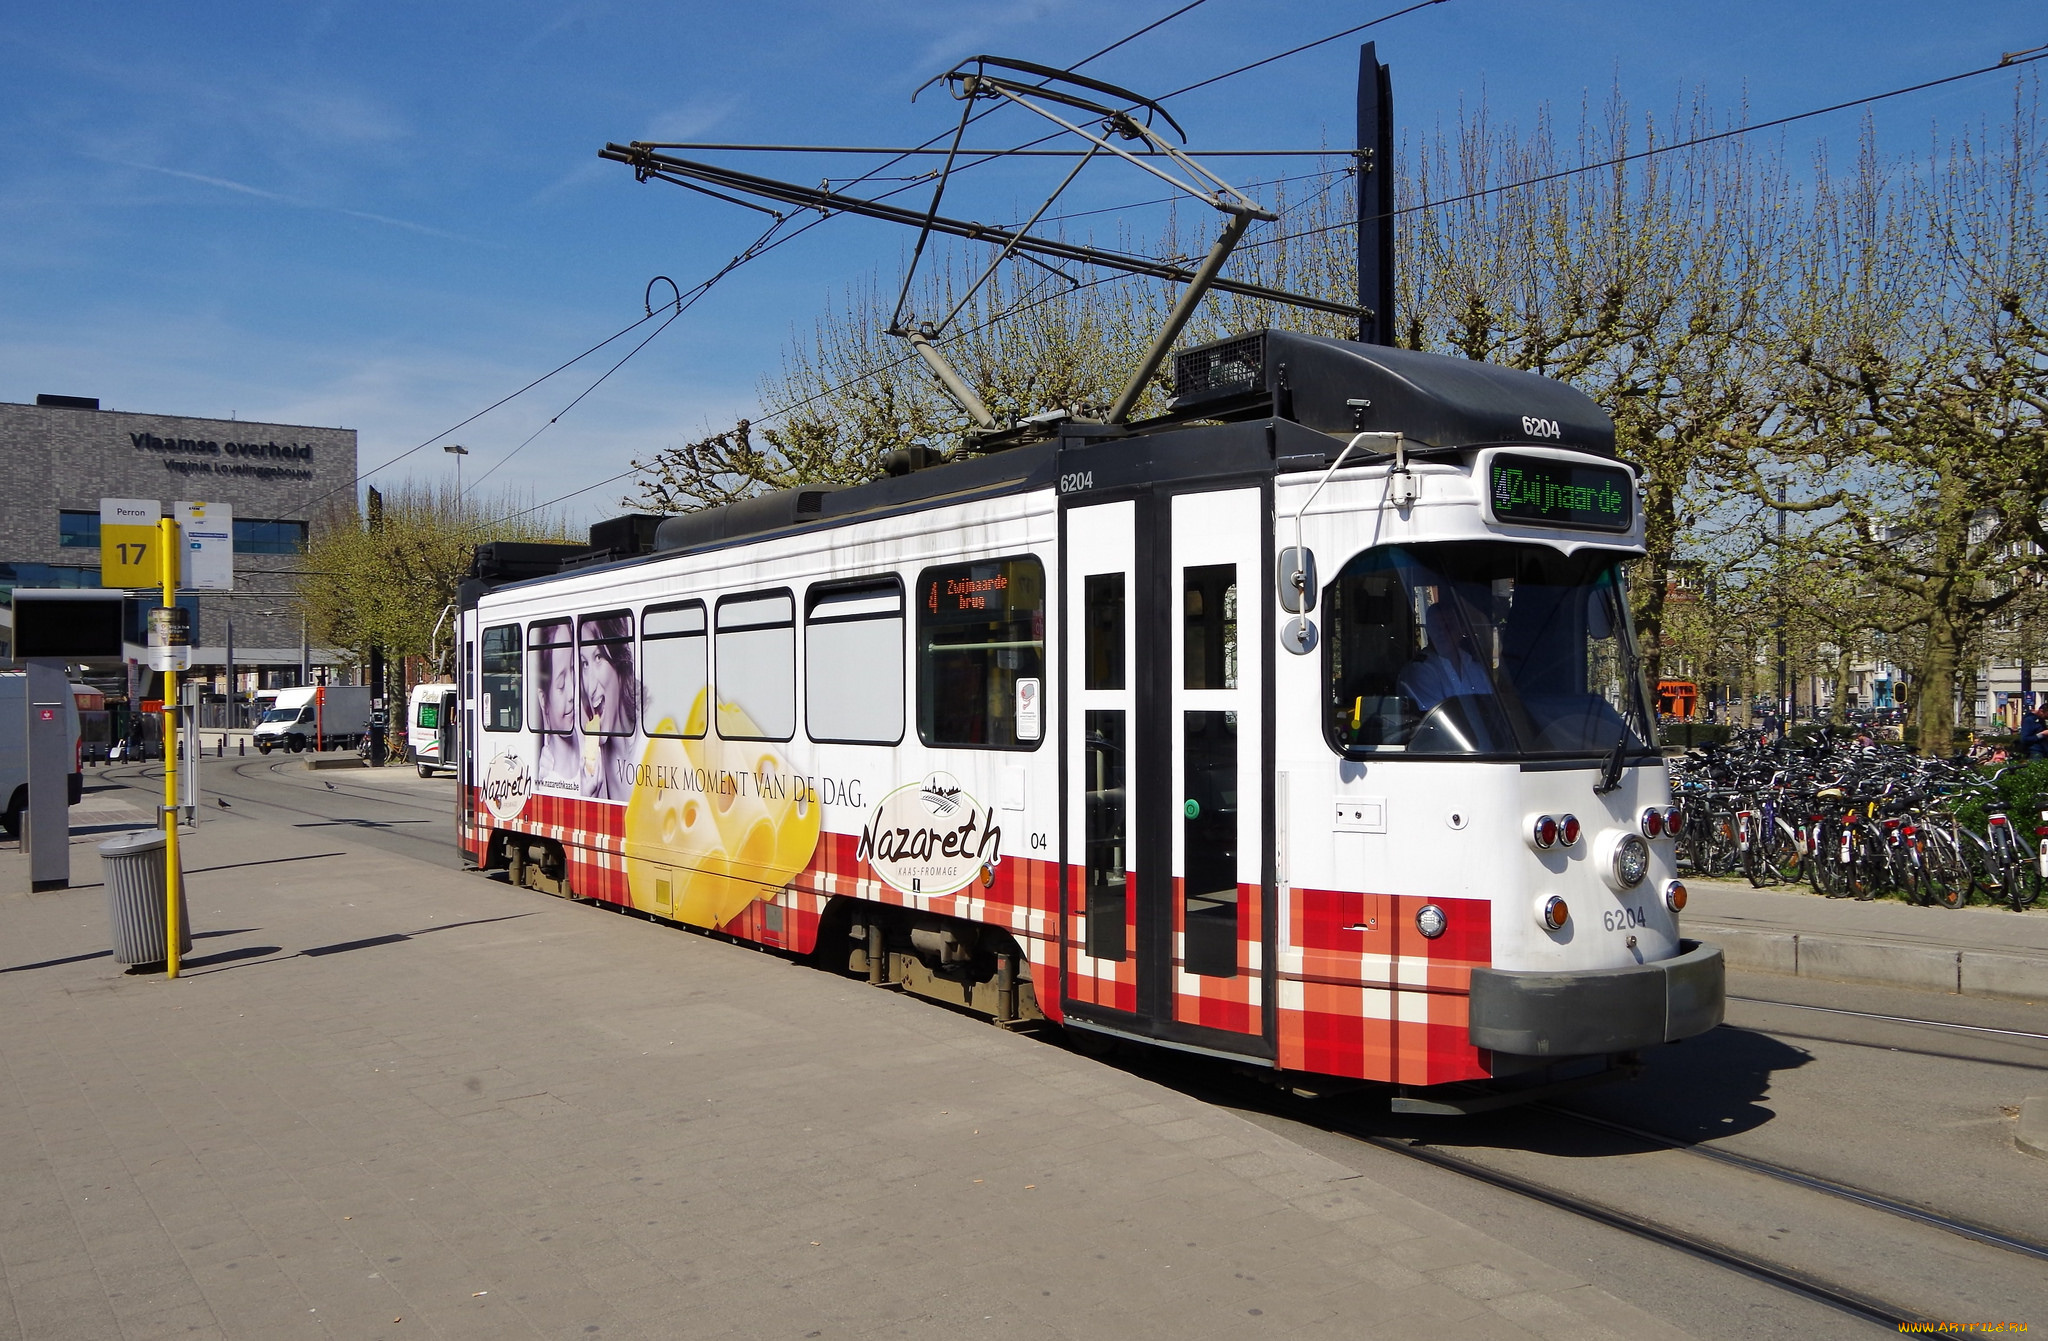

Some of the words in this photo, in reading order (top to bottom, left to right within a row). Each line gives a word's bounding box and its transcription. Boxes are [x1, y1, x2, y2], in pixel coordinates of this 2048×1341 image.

[1521, 415, 1561, 439] 6204
[129, 432, 219, 455] Vlaamse
[224, 441, 312, 461] overheid
[163, 458, 212, 476] Virginie
[214, 462, 312, 481] Lovelinggebouw
[1060, 470, 1093, 493] 6204
[1509, 468, 1622, 514] Zwijnaarde
[116, 507, 146, 516] Perron
[115, 543, 147, 565] 17
[946, 574, 1008, 595] Zwijnaarde
[928, 581, 938, 614] 4
[959, 594, 985, 610] brug
[480, 764, 532, 800] Nazareth
[617, 758, 653, 788] VOOR
[657, 765, 679, 790] ELK
[683, 768, 749, 797] MOMENT
[753, 772, 786, 800] VAN
[793, 775, 815, 803] DE
[822, 777, 867, 808] DAG.
[858, 806, 1001, 863] Nazareth
[1030, 832, 1047, 850] 04
[897, 866, 958, 876] KAAS-FROMAGE
[1603, 905, 1647, 932] 6204
